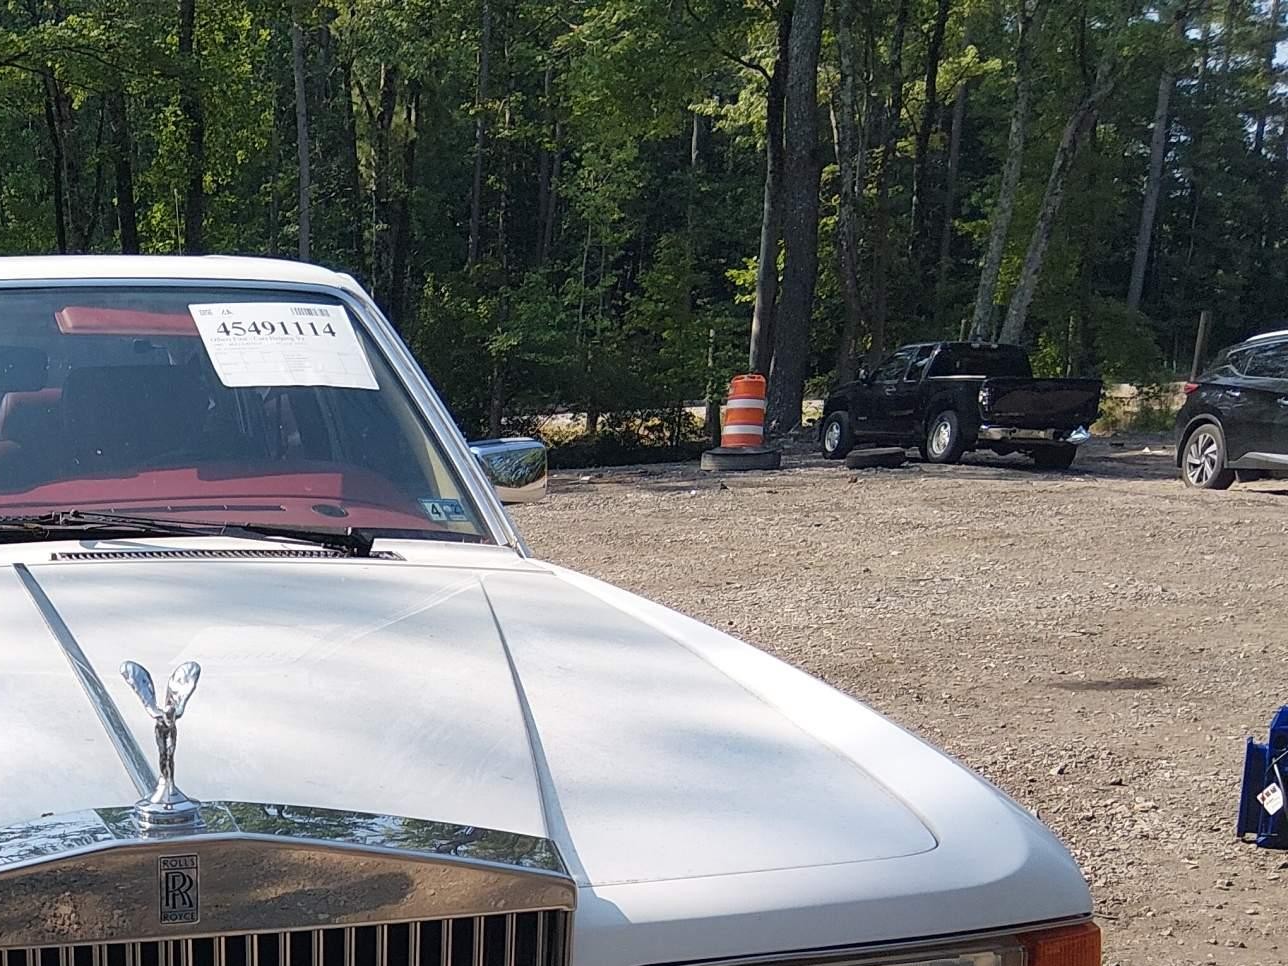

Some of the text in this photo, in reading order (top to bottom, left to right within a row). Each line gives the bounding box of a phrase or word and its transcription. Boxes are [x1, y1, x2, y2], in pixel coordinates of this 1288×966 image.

[216, 321, 336, 337] 45491114
[162, 857, 195, 868] ROLLS
[162, 911, 196, 922] ROYCE
